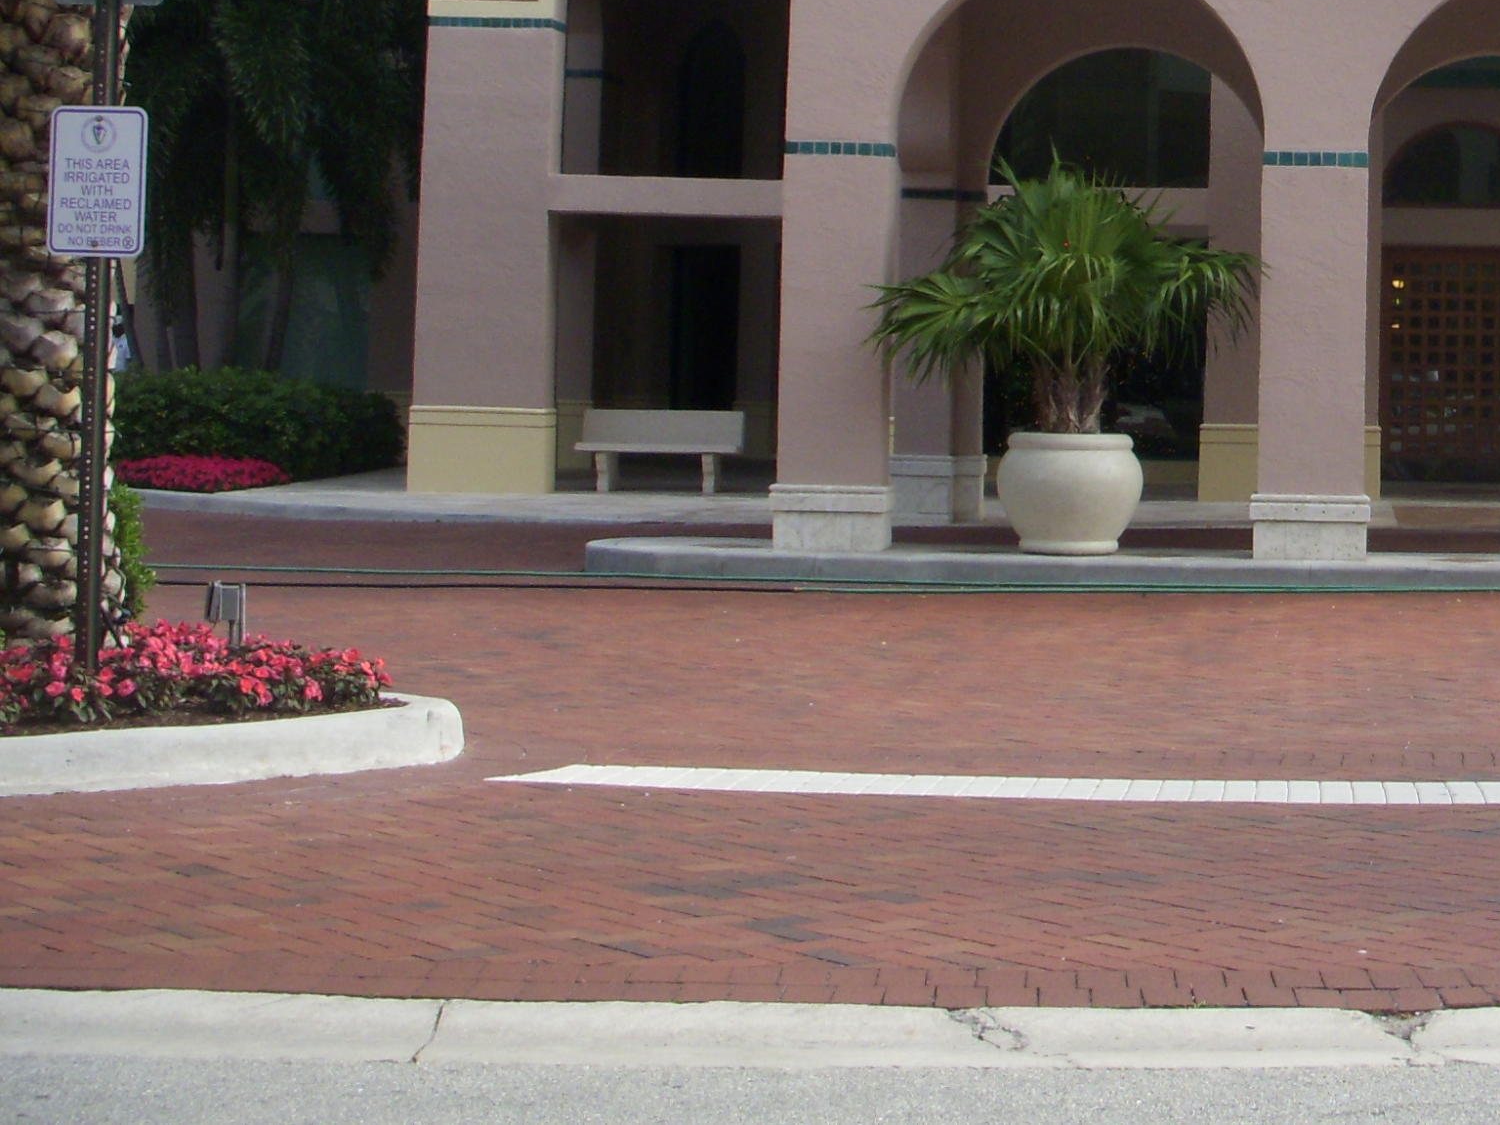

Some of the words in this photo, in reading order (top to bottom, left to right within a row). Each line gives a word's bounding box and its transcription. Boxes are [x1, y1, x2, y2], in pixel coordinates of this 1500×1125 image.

[65, 158, 92, 170] THIS
[96, 159, 129, 170] AREA
[64, 172, 129, 184] IRRIGATED
[81, 185, 113, 195] WITH
[60, 198, 132, 210] RECLAIMED
[75, 211, 116, 222] WATER
[58, 223, 73, 233] DO
[76, 224, 96, 234] NOT
[100, 224, 132, 234] DRINK
[68, 236, 83, 245] NO
